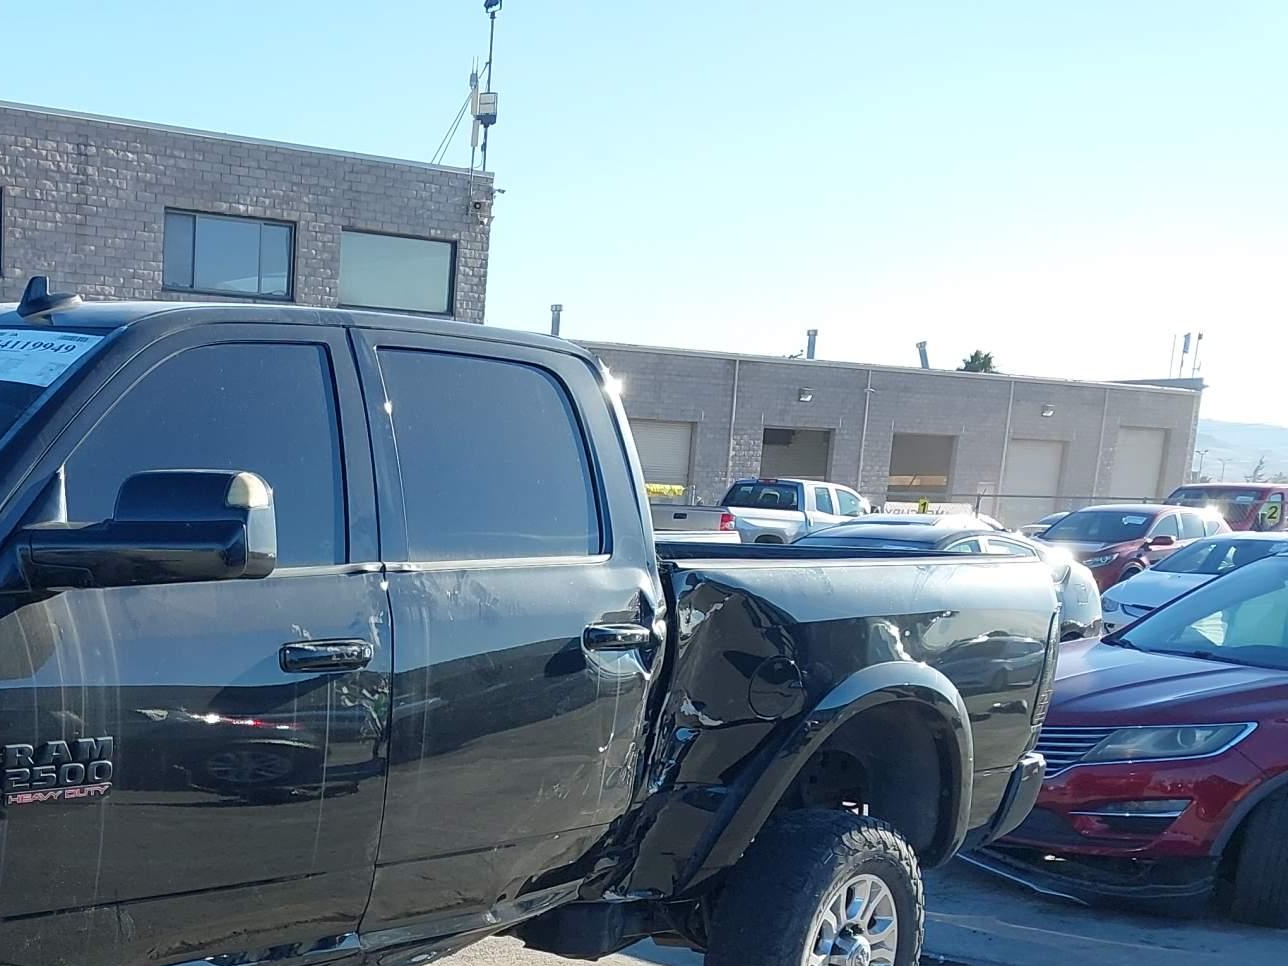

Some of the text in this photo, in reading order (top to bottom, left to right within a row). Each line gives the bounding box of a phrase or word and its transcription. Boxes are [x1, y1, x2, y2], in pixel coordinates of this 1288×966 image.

[920, 501, 928, 514] 1
[1268, 505, 1278, 519] 2
[5, 736, 114, 767] RAM
[5, 760, 114, 789] 2500
[8, 786, 110, 804] HEAVY DUTY
